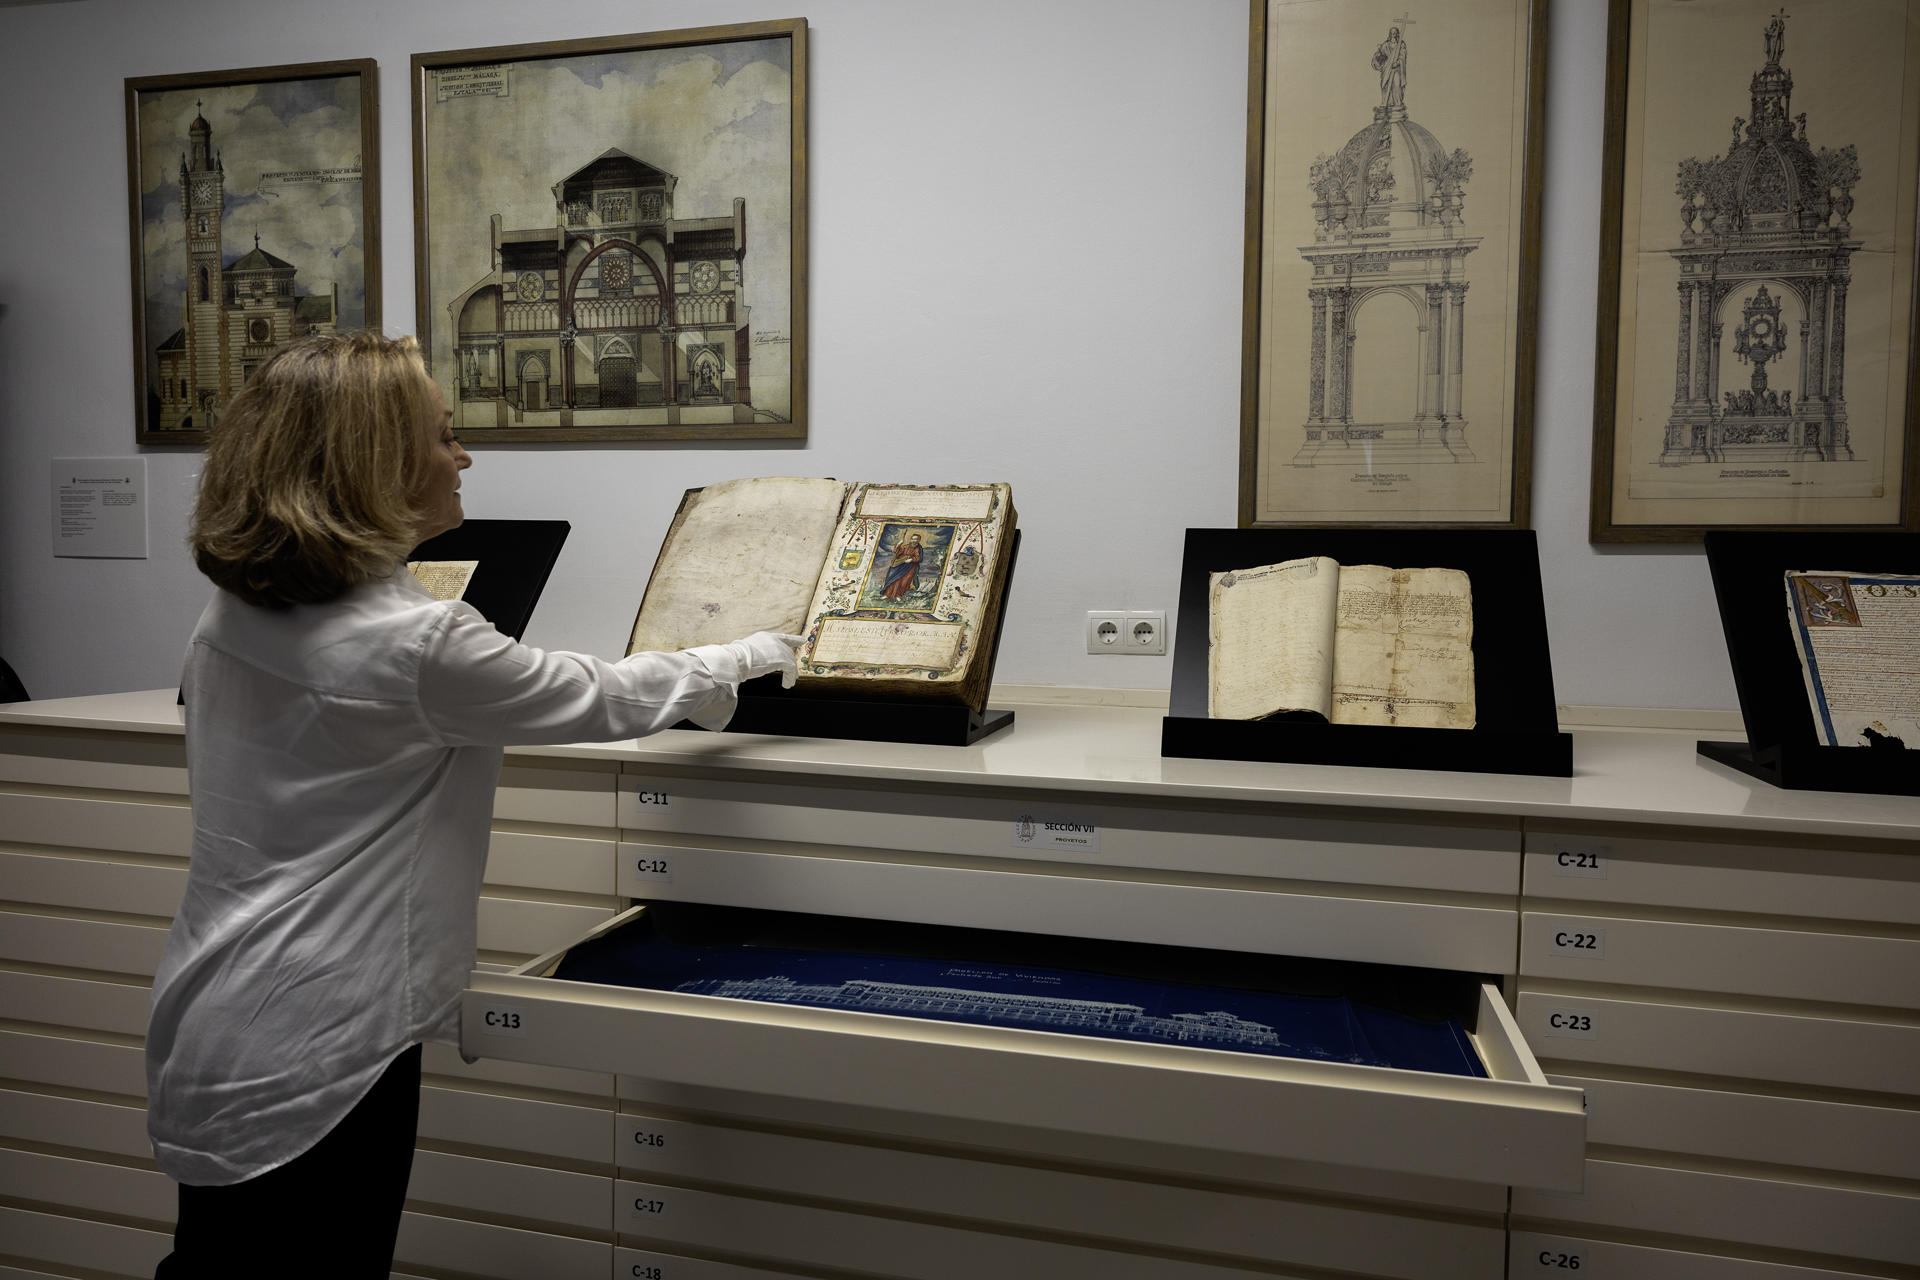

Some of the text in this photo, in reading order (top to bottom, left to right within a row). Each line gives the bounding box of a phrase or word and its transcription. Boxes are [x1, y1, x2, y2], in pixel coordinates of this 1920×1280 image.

[639, 791, 668, 806] C-11
[1044, 822, 1095, 833] SECCIÓN VII
[638, 859, 667, 874] C-12
[1557, 853, 1600, 869] C-21
[1555, 932, 1597, 950] C-22
[485, 1010, 521, 1029] C-13
[1550, 1013, 1592, 1031] C-23
[634, 1132, 664, 1147] C-16
[634, 1199, 664, 1214] C-17
[1538, 1251, 1580, 1270] C-26
[632, 1265, 662, 1280] C-18
